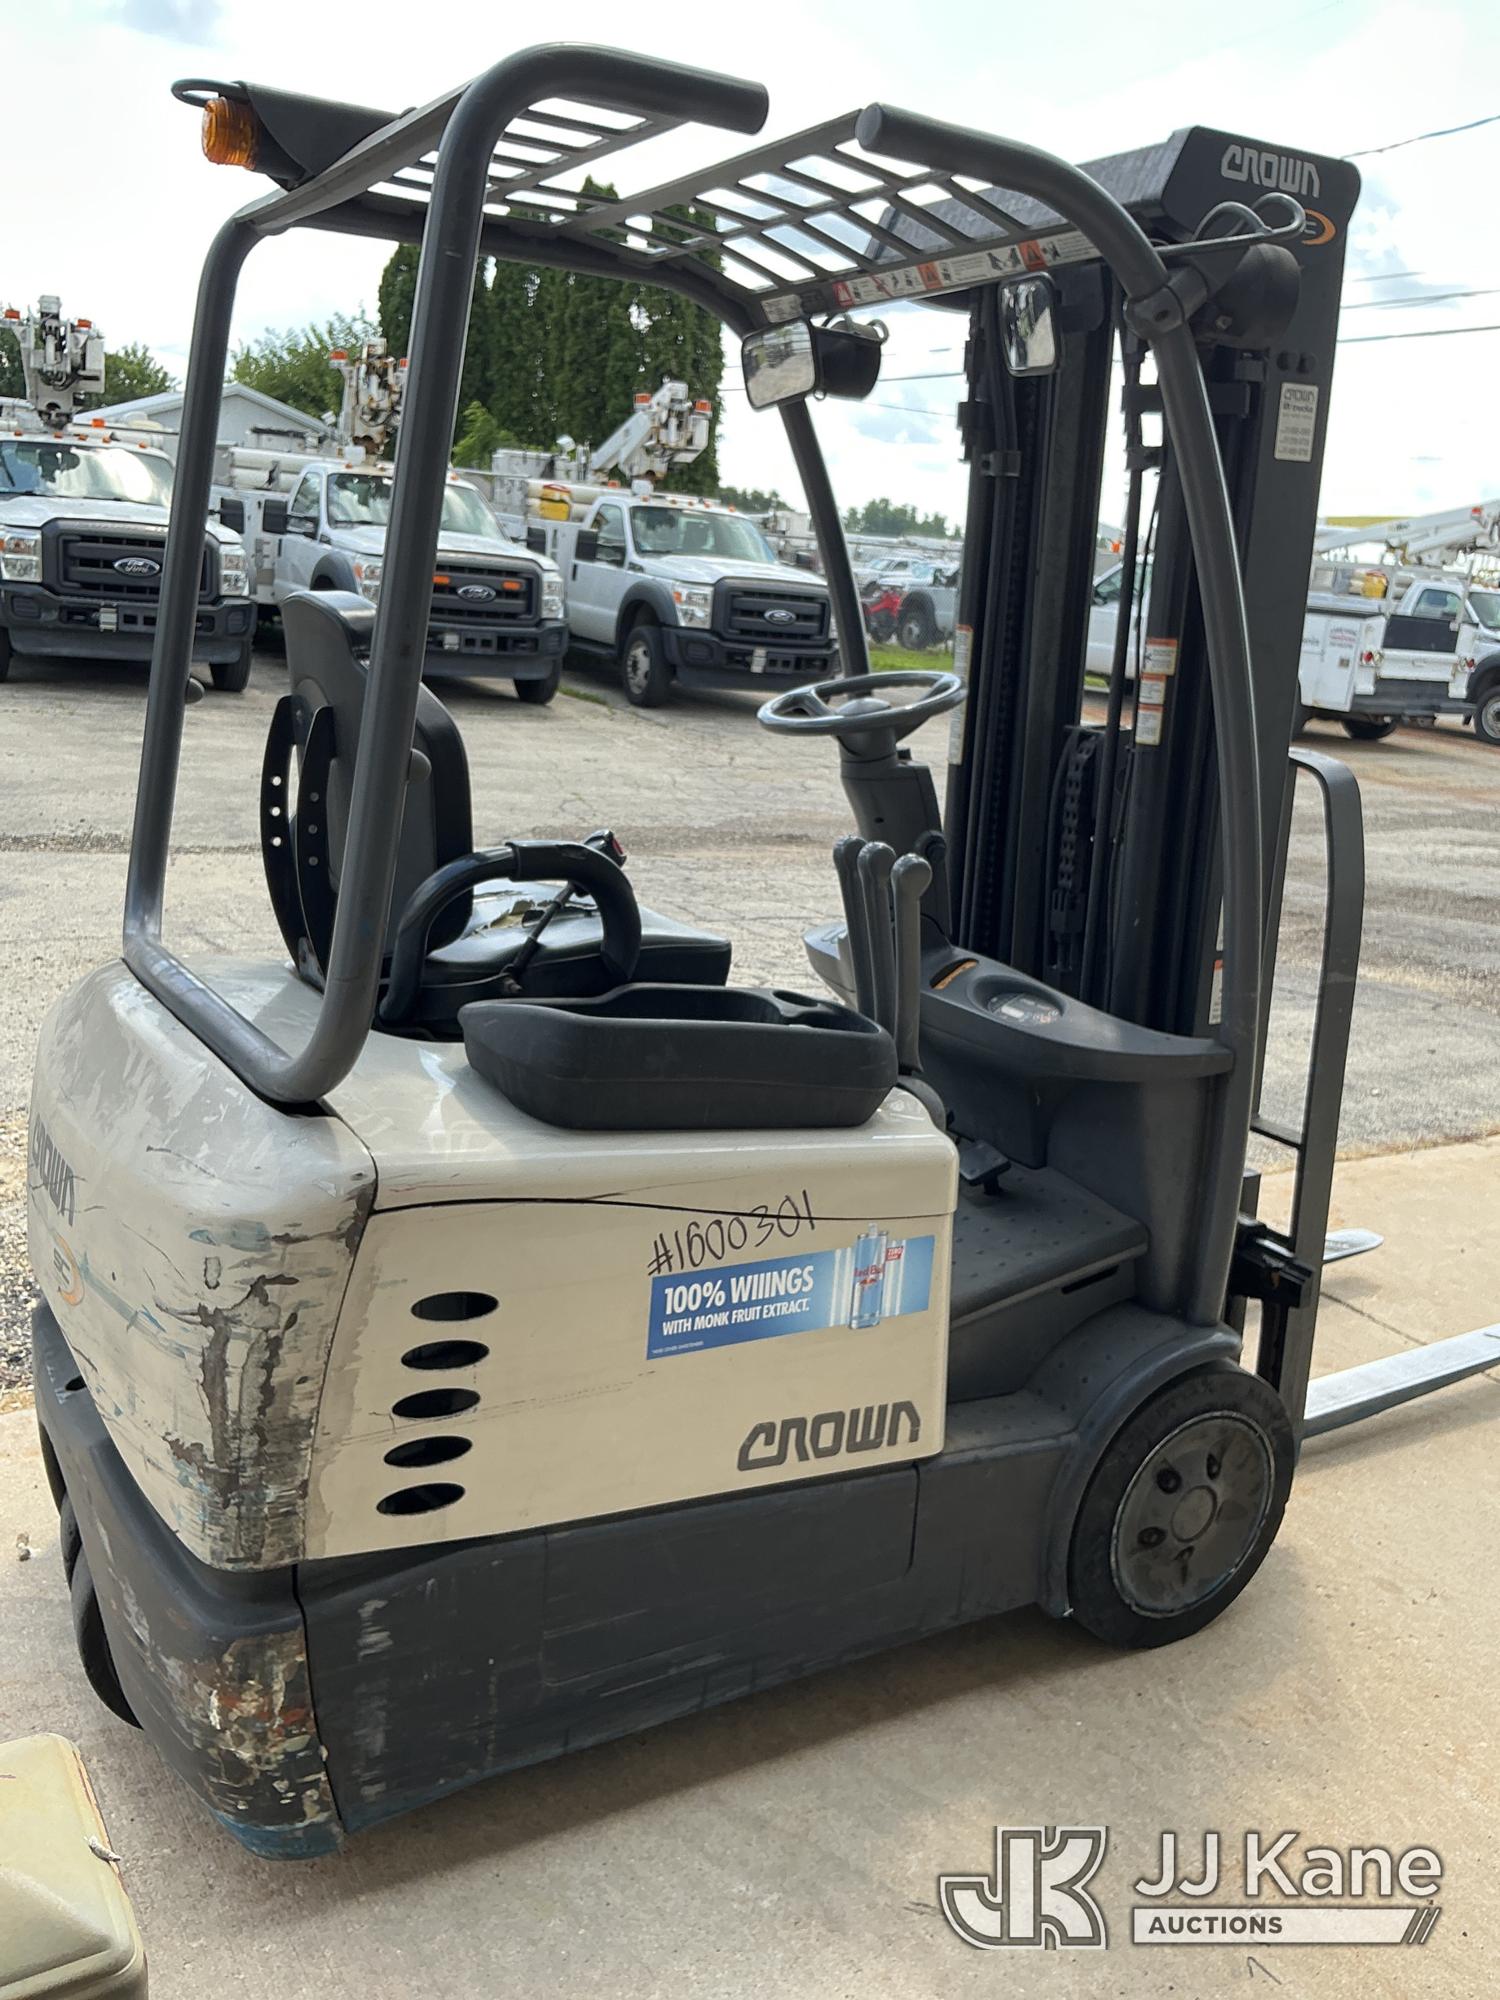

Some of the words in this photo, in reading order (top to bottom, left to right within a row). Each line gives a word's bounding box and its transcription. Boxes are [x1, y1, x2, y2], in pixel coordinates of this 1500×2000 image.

[1221, 144, 1320, 199] CROWN
[120, 558, 154, 576] Ford
[647, 1190, 815, 1276] #1600301
[664, 1279, 726, 1315] 100%
[730, 1265, 814, 1303] WIIINGS
[662, 1316, 692, 1336] WITH
[693, 1311, 729, 1331] MONK
[731, 1306, 762, 1324] FRUIT
[762, 1297, 810, 1319] EXTRACT.
[737, 1400, 921, 1471] CROWN
